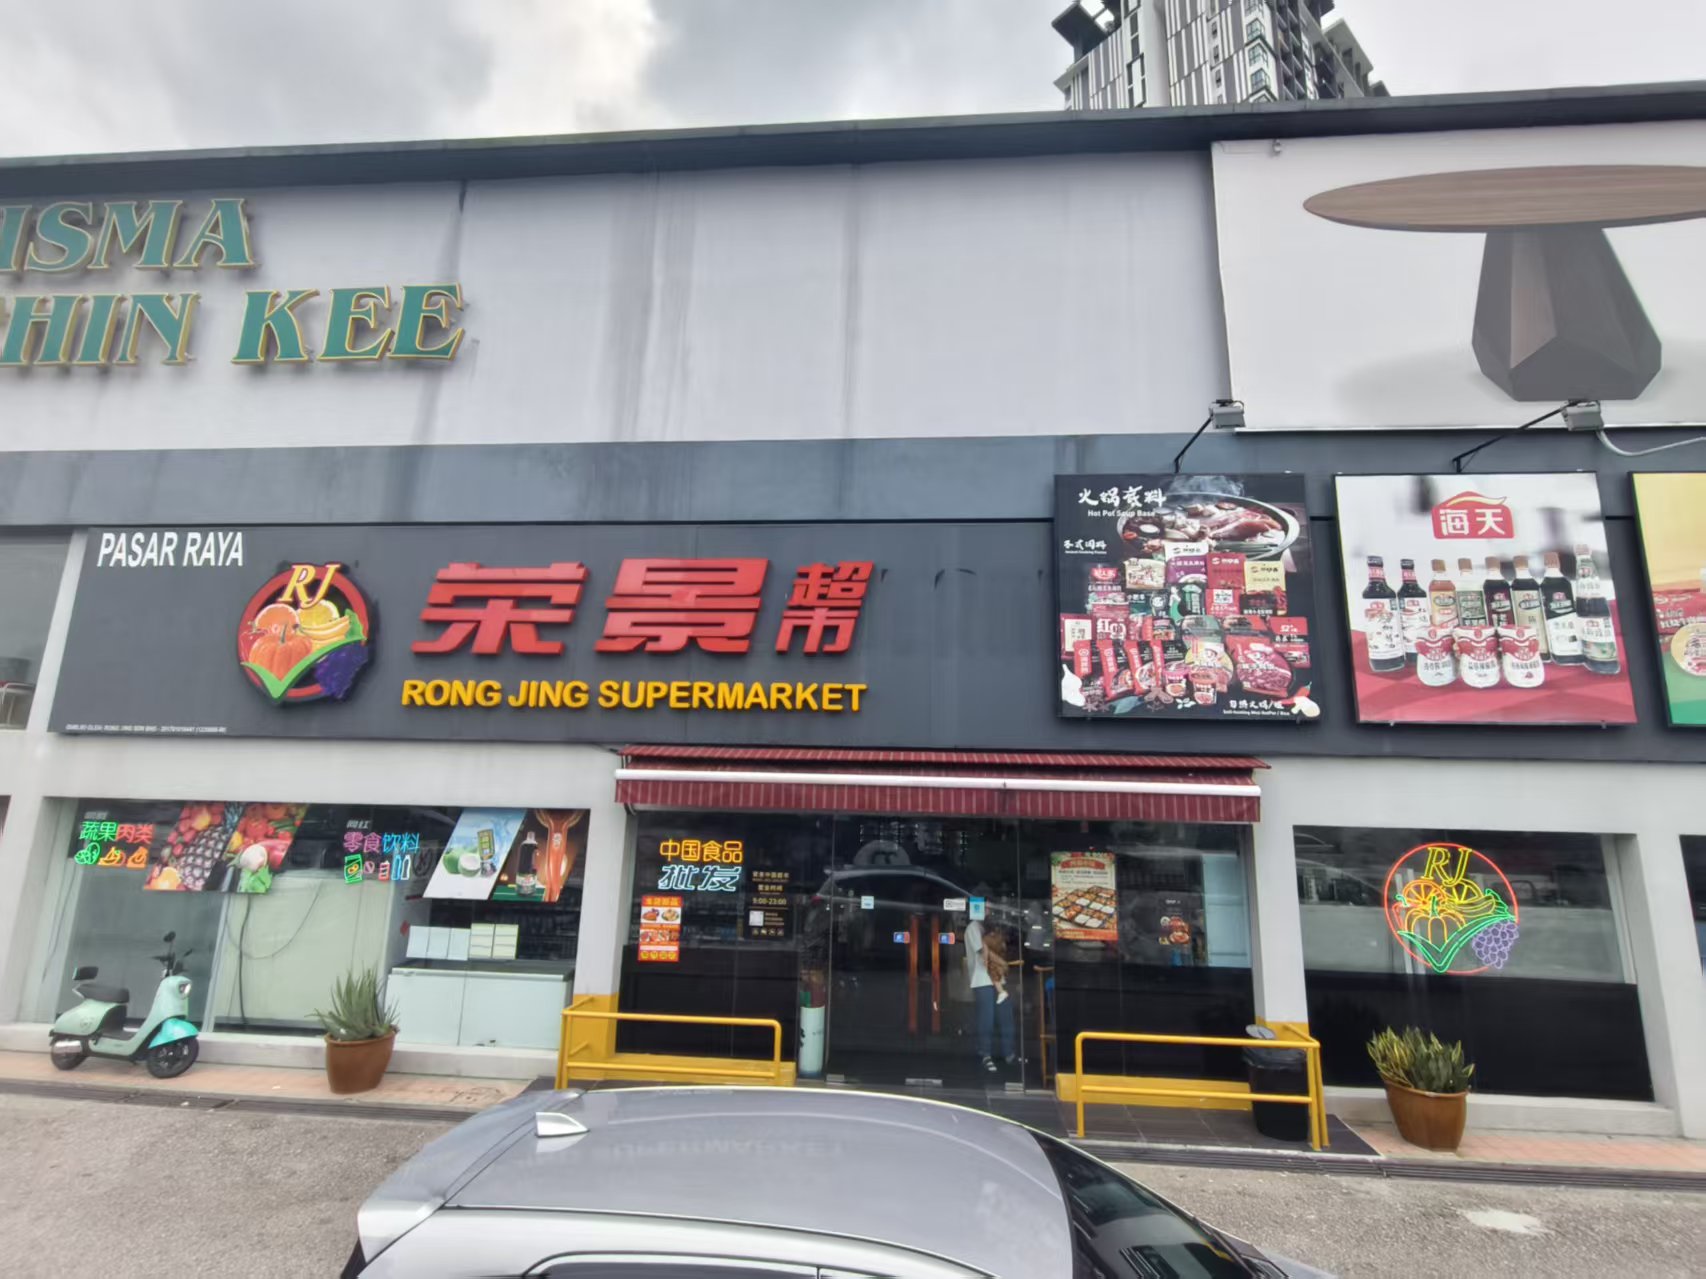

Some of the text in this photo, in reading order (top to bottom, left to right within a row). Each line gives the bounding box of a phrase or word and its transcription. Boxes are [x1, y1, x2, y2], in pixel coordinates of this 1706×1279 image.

[0, 283, 466, 366] HIN KEE
[1439, 508, 1505, 536] 海天
[97, 532, 244, 567] PASAR RAYA
[281, 563, 340, 608] RJ
[401, 679, 868, 711] RONG JING SUPERMARKET
[79, 821, 154, 844] 蔬果肉类
[344, 832, 420, 853] 零食饮料
[659, 839, 743, 863] 中国食品
[1421, 847, 1473, 886] RJ
